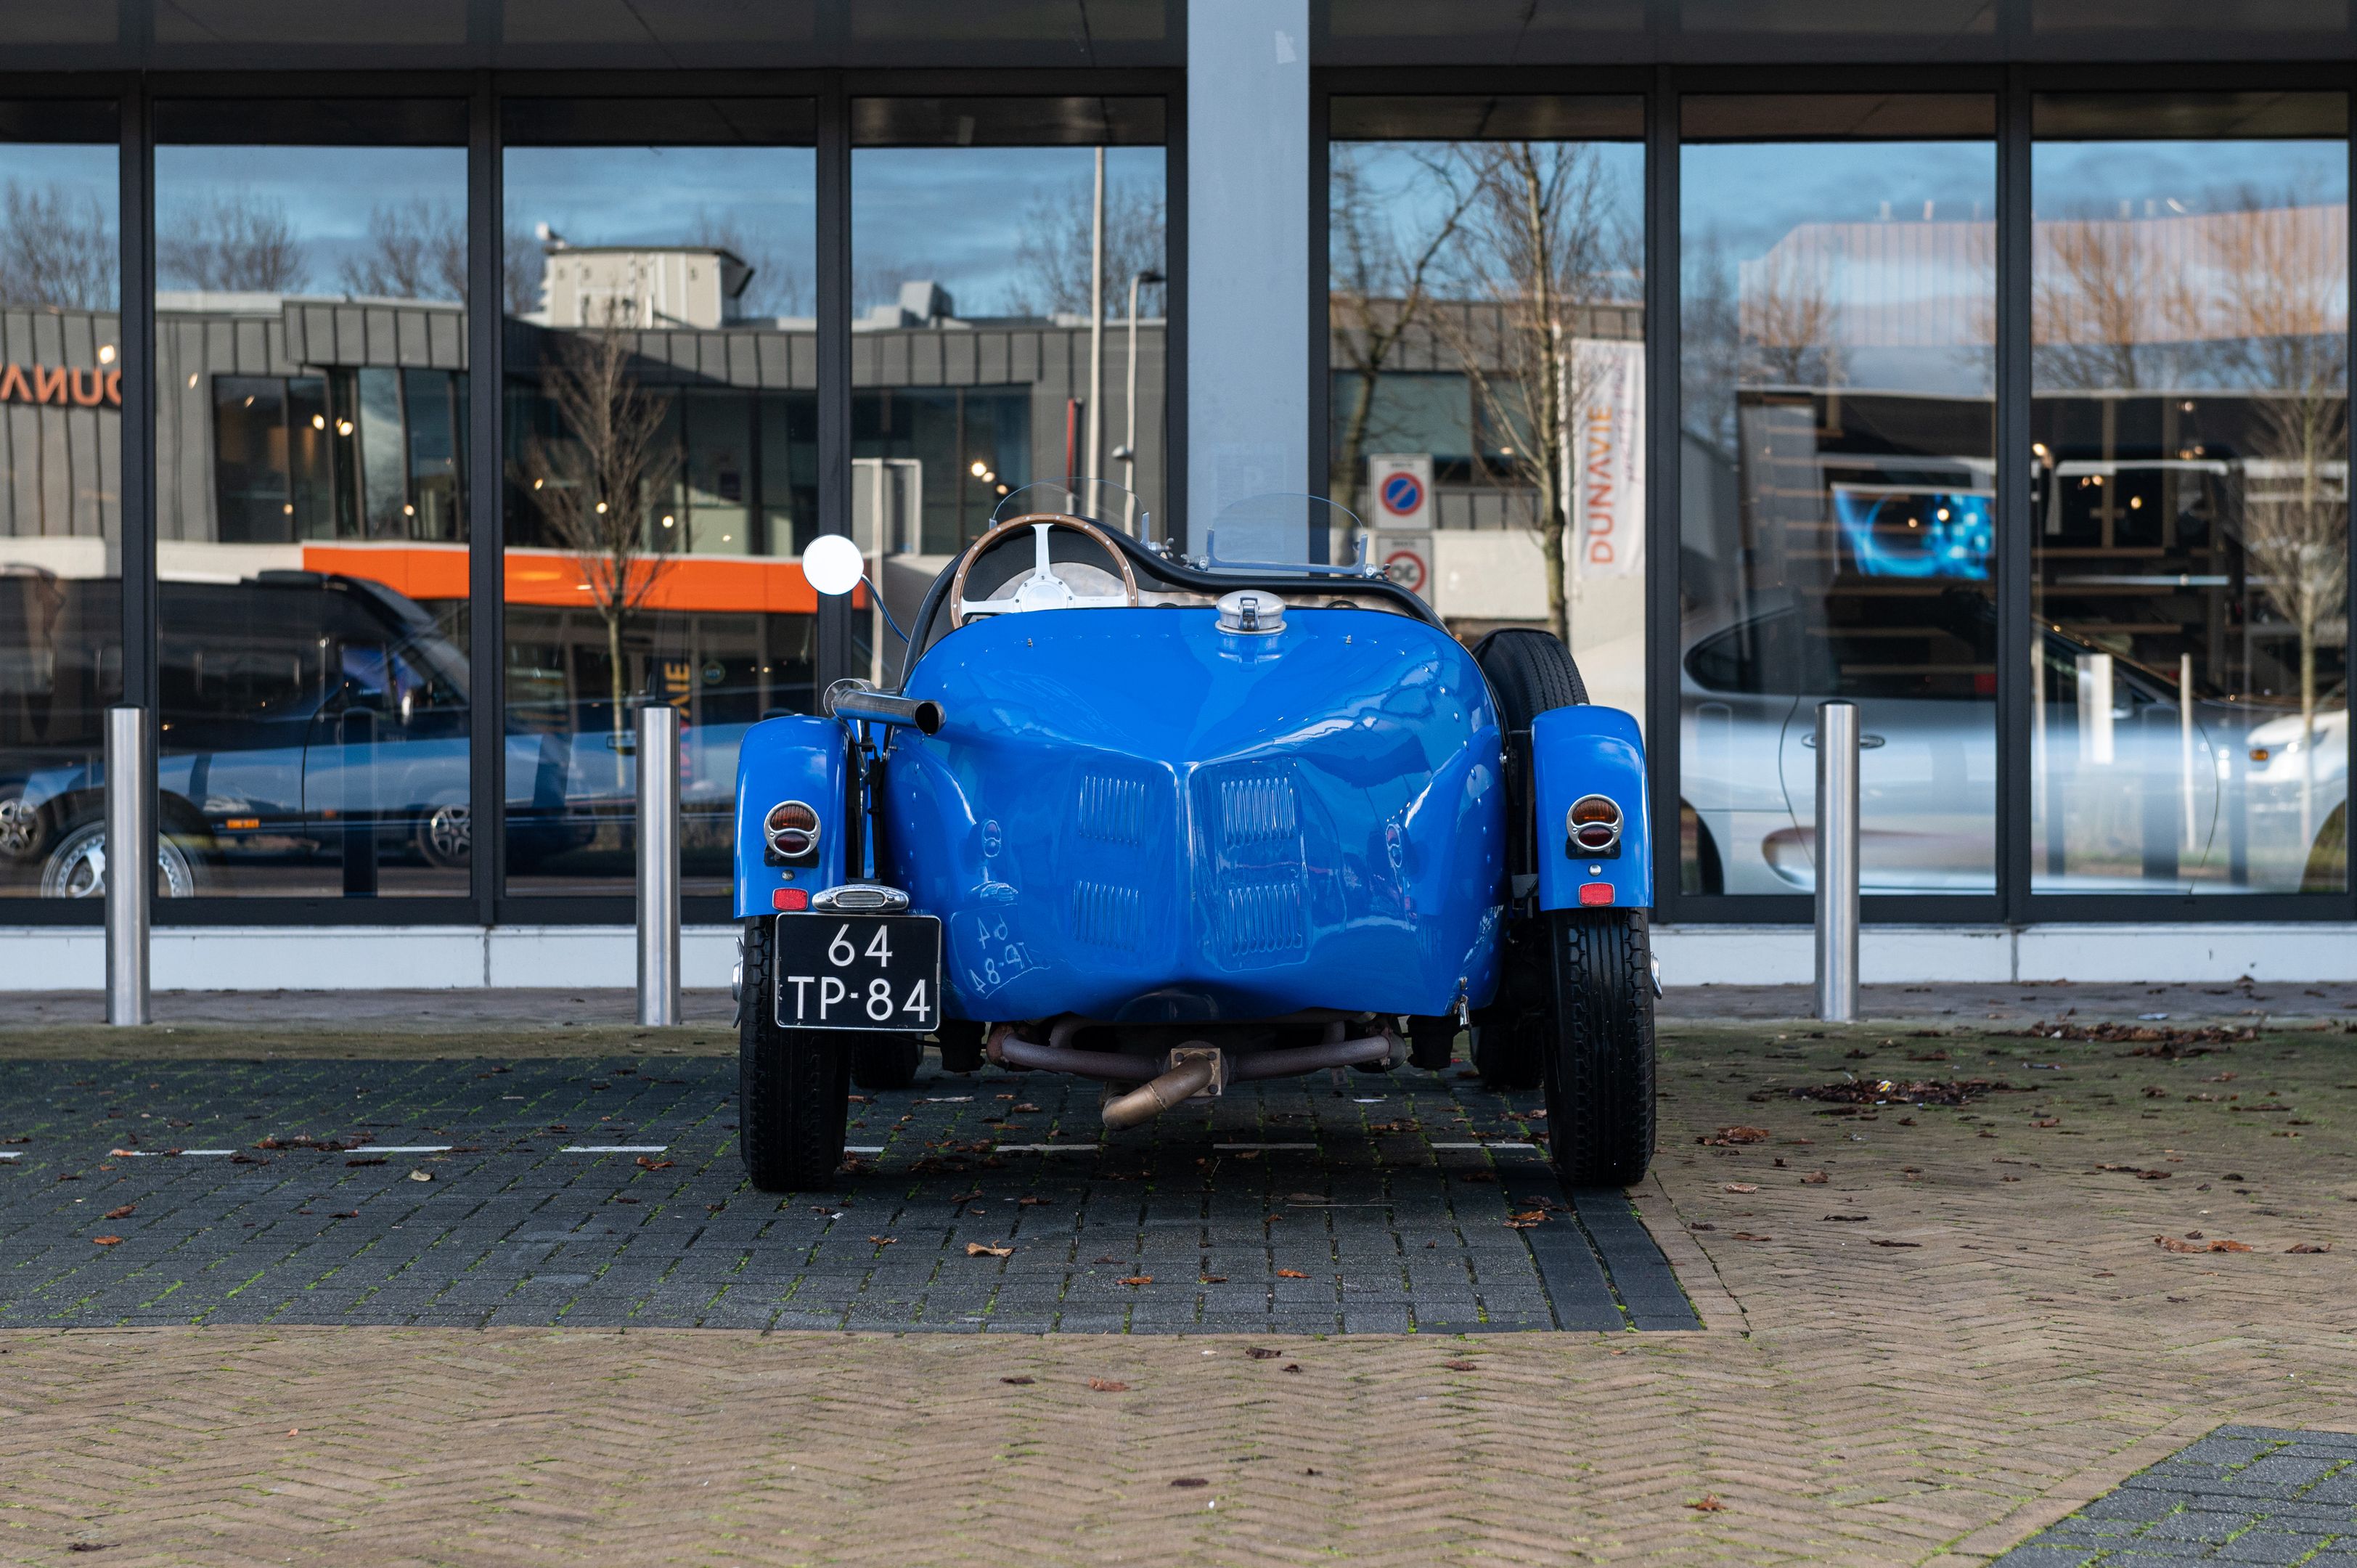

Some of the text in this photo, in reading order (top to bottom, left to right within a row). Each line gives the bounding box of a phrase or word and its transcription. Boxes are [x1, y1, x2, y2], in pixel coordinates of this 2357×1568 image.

[1588, 405, 1614, 564] DUNAVIE
[828, 923, 894, 968] 64
[788, 976, 931, 1022] TP-84
